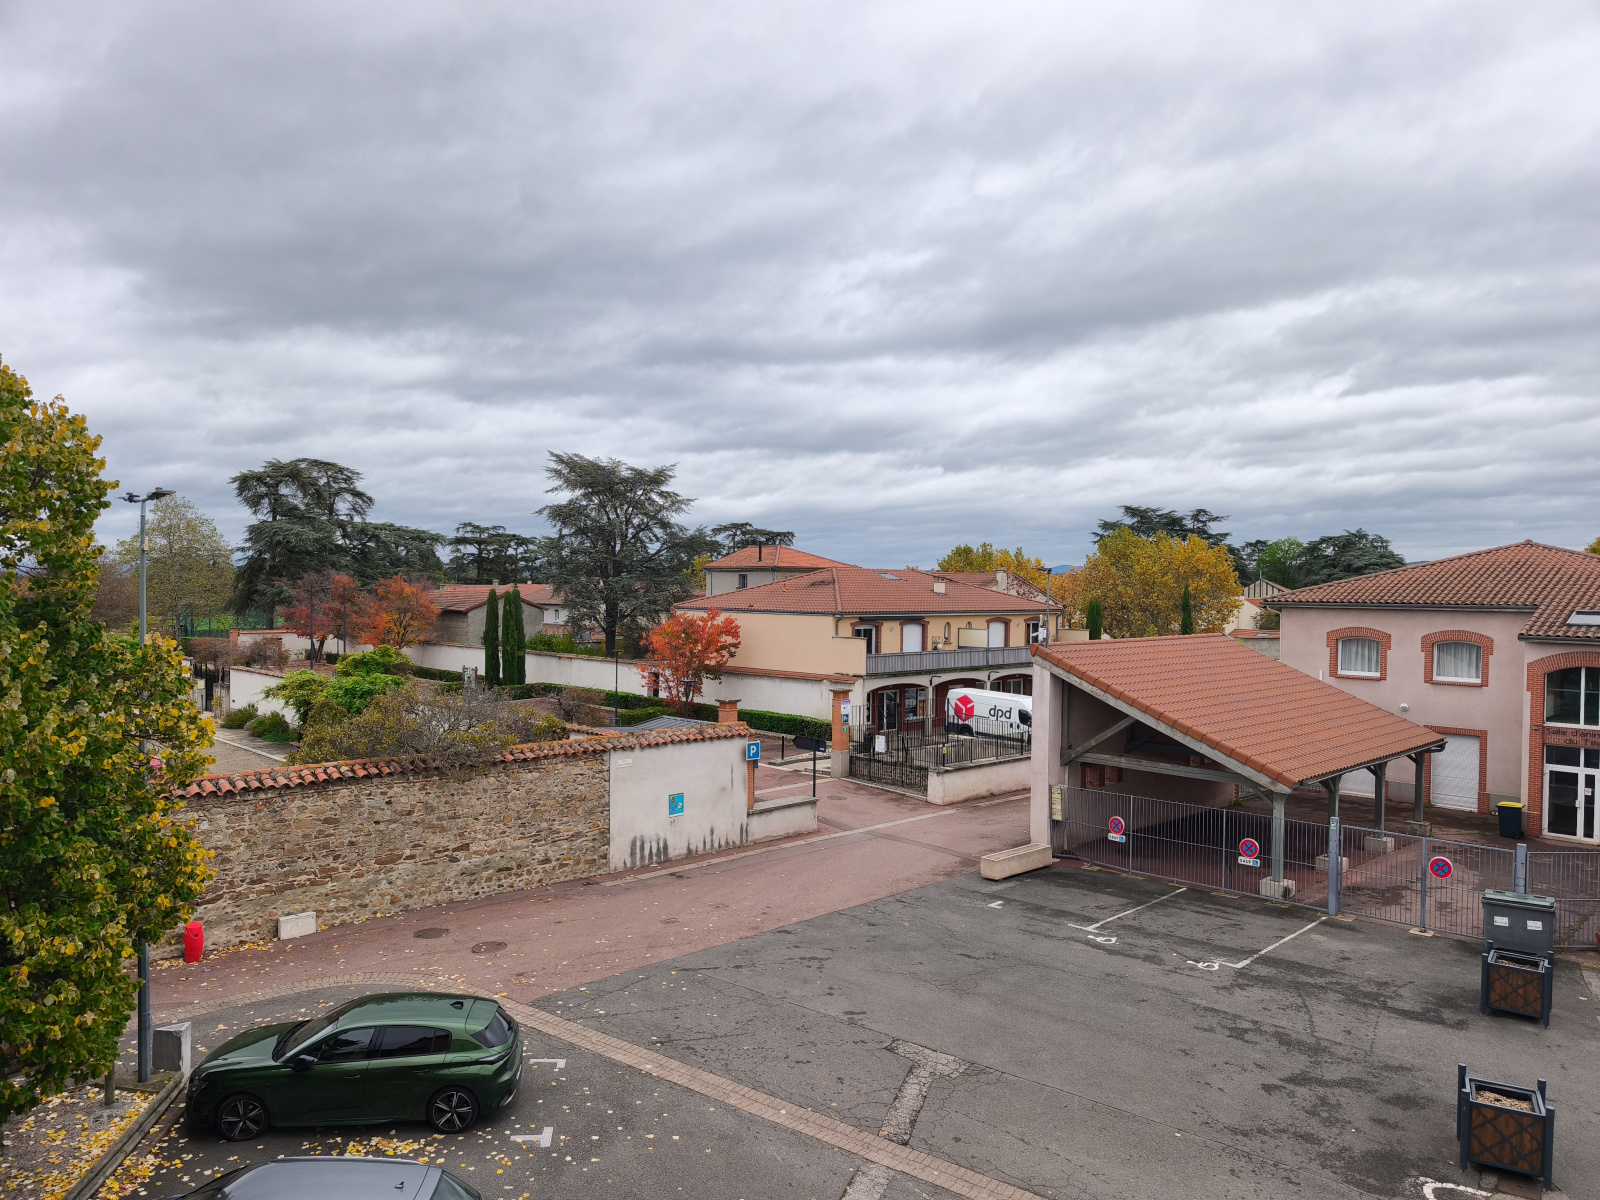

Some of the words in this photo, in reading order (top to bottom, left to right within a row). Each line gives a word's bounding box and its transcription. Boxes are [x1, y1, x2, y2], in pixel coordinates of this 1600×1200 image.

[989, 705, 1012, 721] dpd
[1546, 728, 1567, 736] Salle
[750, 745, 757, 757] P
